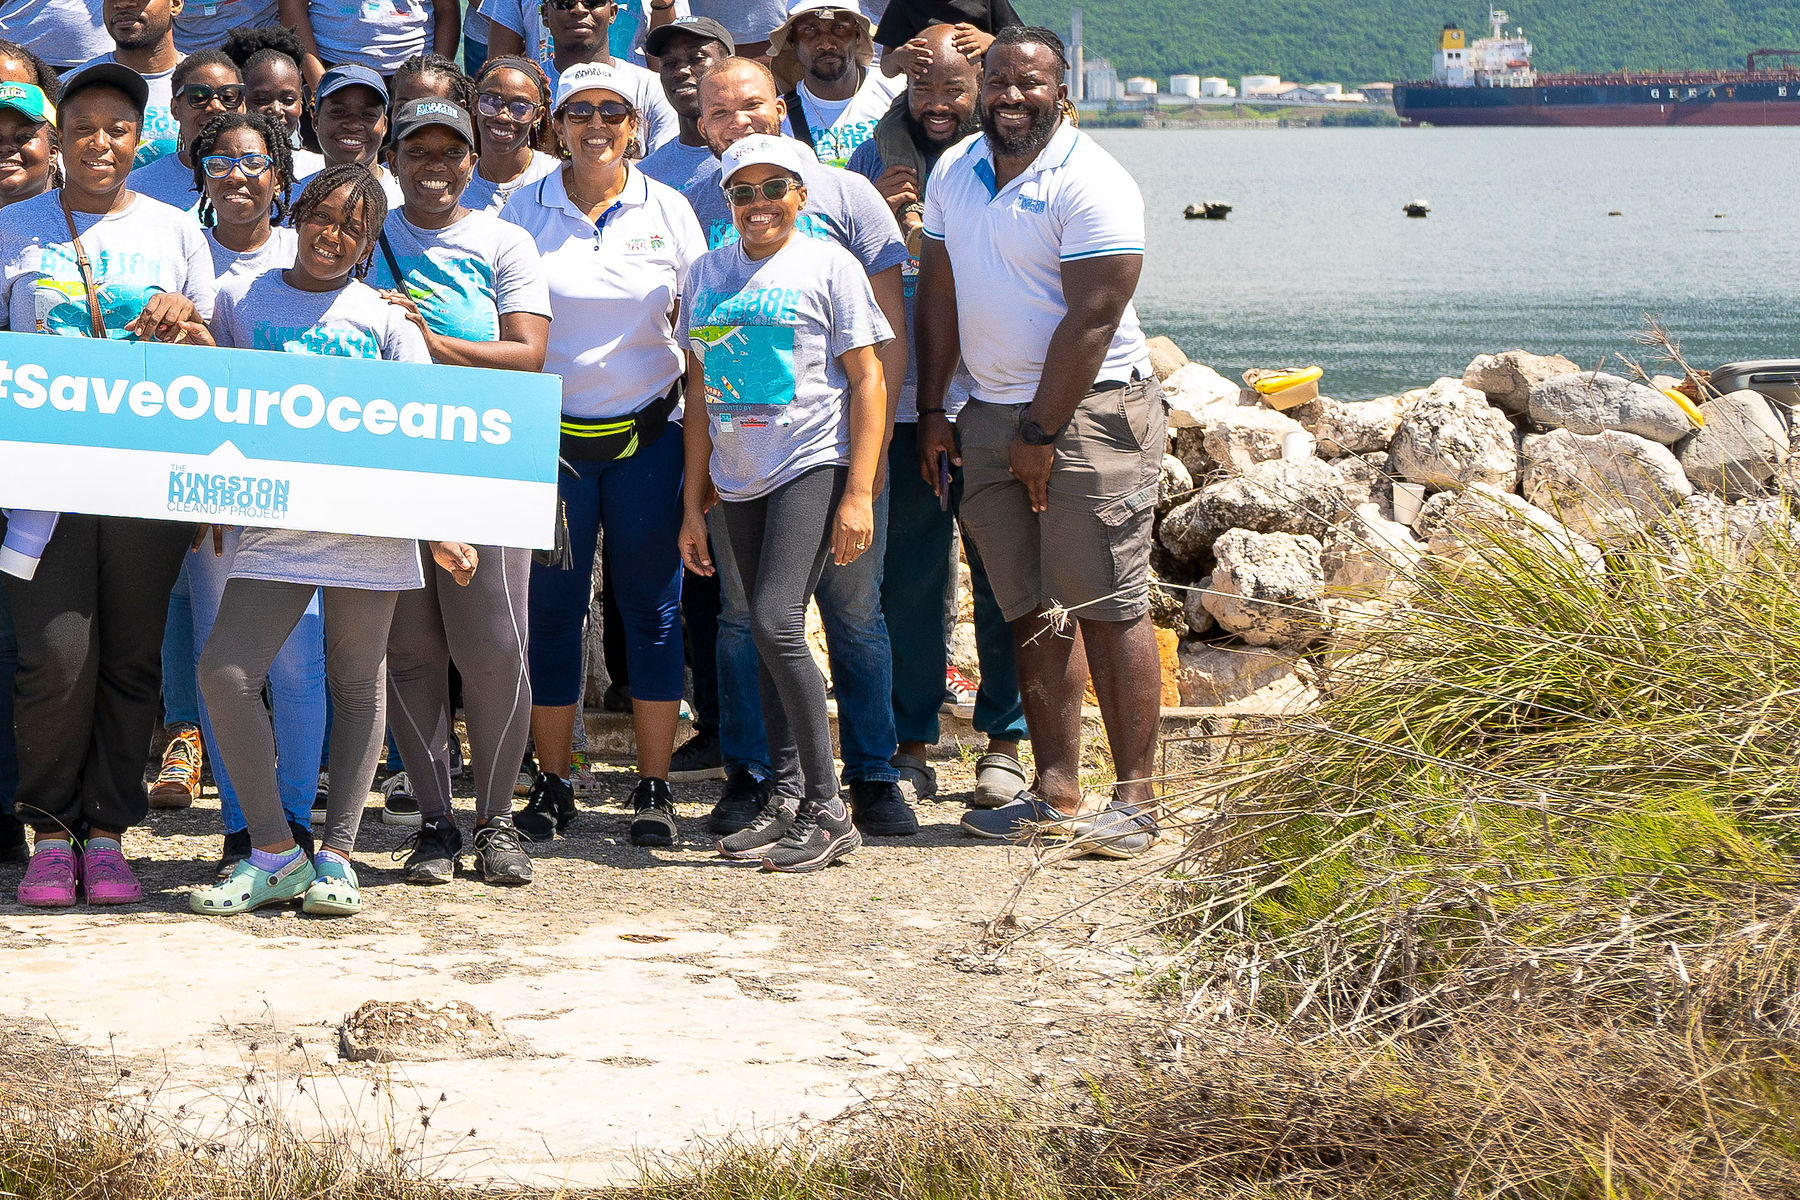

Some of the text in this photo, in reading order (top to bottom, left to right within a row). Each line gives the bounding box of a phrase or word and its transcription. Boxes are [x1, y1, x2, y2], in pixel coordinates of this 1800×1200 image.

[1650, 87, 1735, 99] GREAT
[168, 471, 290, 496] KINGSTON
[166, 501, 288, 520] CLEANUP PROJECT
[168, 487, 289, 512] HARBOUR
